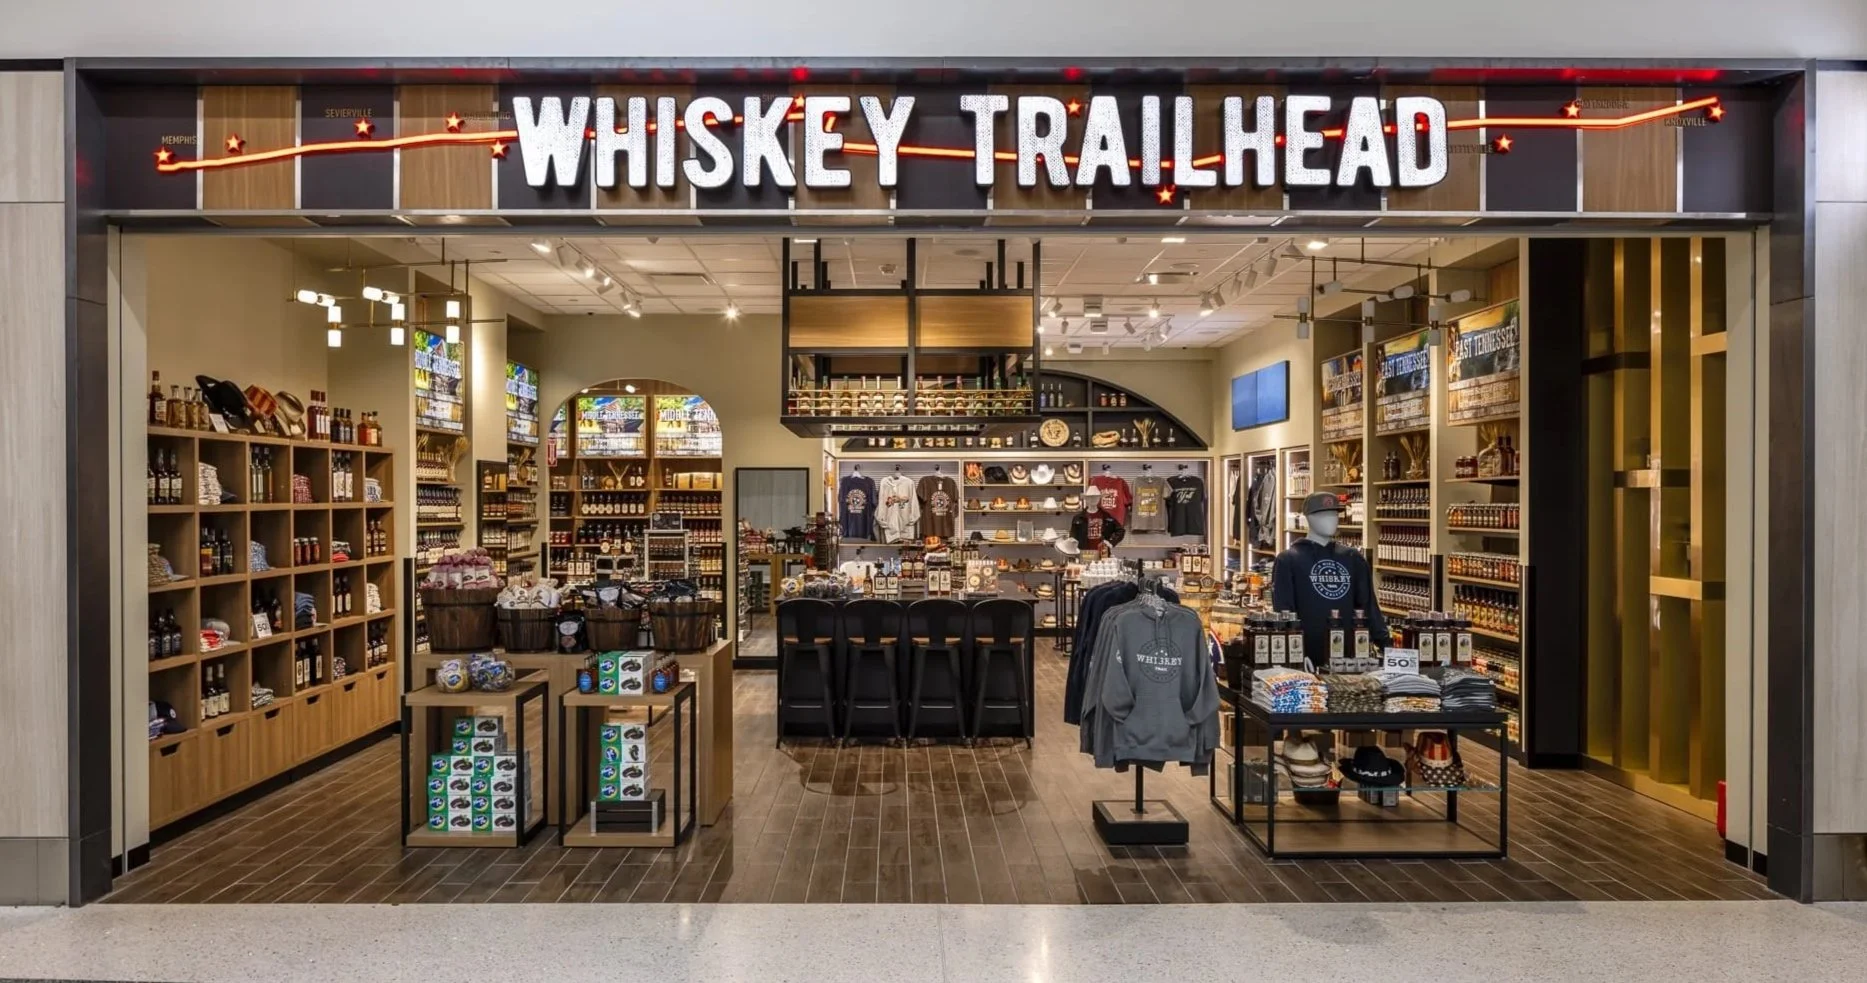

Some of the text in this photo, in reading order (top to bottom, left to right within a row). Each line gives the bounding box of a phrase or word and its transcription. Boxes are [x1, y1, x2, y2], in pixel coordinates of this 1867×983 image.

[325, 108, 373, 117] SEVIERVILLE
[1664, 116, 1706, 127] KNOXVILLE
[161, 135, 197, 145] MEMPHIS
[512, 95, 1448, 188] WHISKEY TRAILHEAD
[1455, 337, 1472, 361] EAST
[1387, 658, 1410, 668] 50
